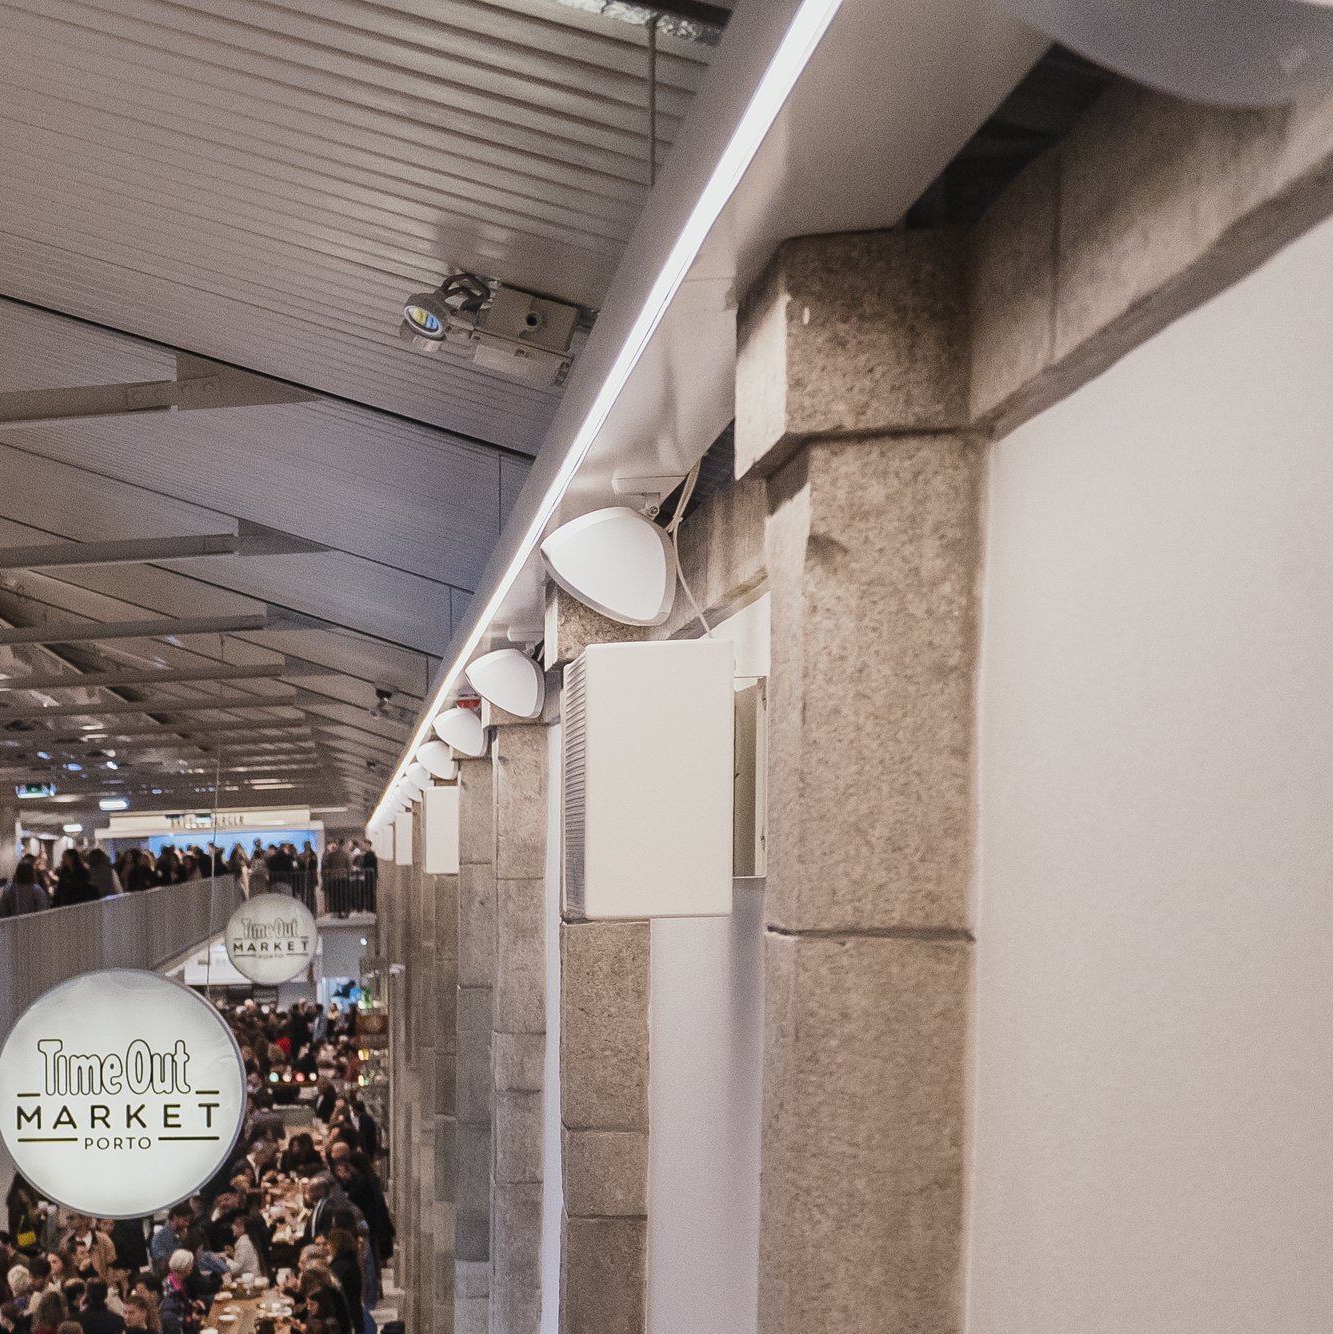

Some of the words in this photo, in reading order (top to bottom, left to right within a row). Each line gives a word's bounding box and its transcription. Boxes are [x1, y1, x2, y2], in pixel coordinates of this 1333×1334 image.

[232, 940, 309, 953] MARKET
[37, 1038, 122, 1096] Time
[126, 1038, 191, 1095] Out
[17, 1102, 220, 1130] MARKET
[83, 1137, 151, 1151] PORTO
